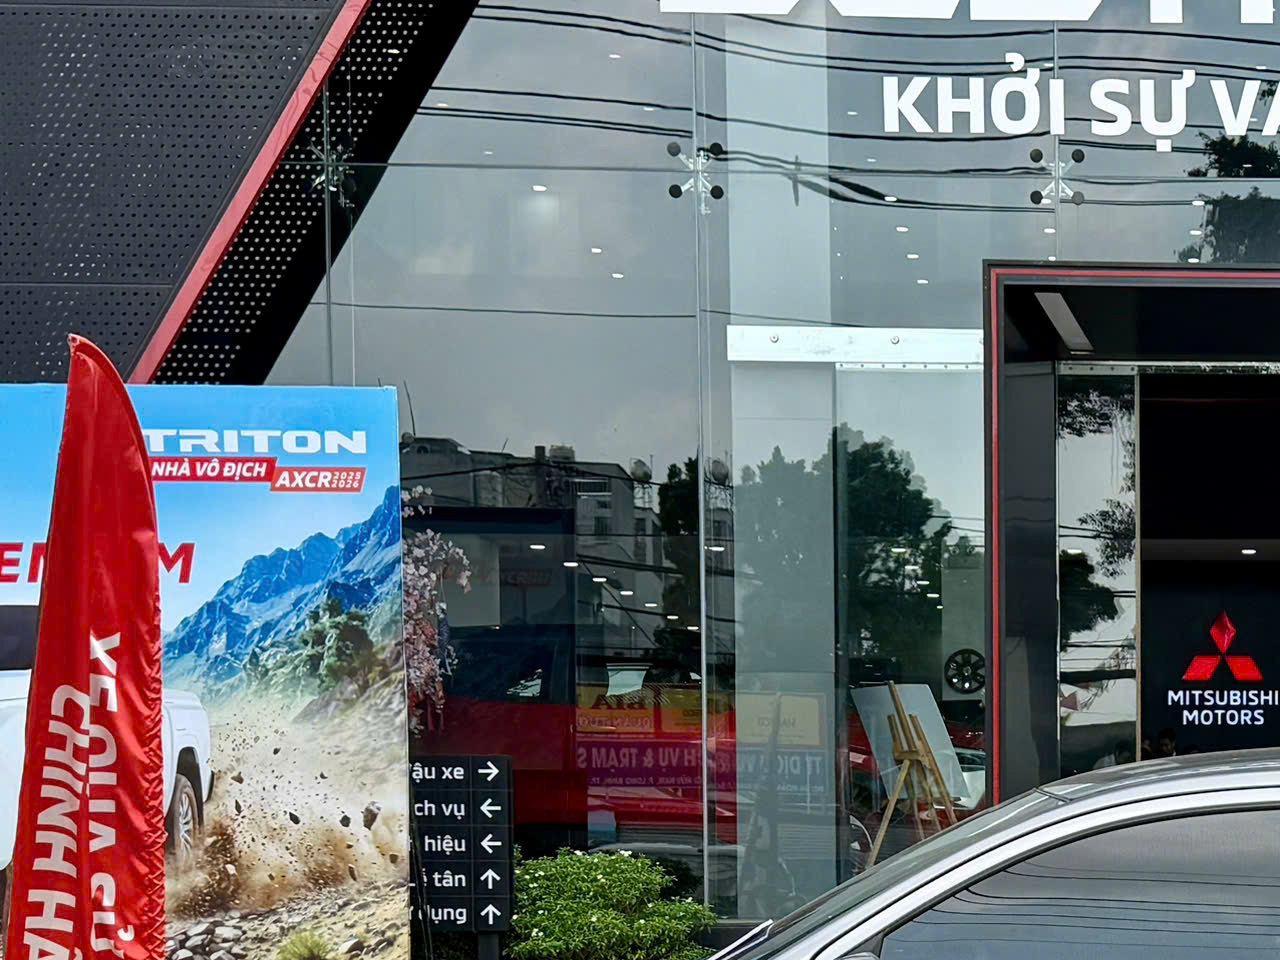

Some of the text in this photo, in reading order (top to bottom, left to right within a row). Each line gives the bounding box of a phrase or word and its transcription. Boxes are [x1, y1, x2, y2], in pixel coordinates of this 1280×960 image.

[883, 52, 1065, 135] KHỞI
[1090, 69, 1196, 152] SỰ
[143, 429, 367, 454] TRITON
[152, 458, 267, 481] NHÀ VÔ ĐỊCH
[275, 471, 331, 488] AXCR
[332, 471, 361, 480] 2025
[331, 480, 360, 488] 2026
[1168, 690, 1279, 705] MITSUBISHI
[1183, 710, 1264, 725] MOTORS
[32, 684, 90, 878] CHÍNH
[410, 762, 464, 783] ậu xe
[414, 800, 465, 820] ch vụ
[424, 834, 466, 855] hiệu
[432, 870, 466, 887] tân
